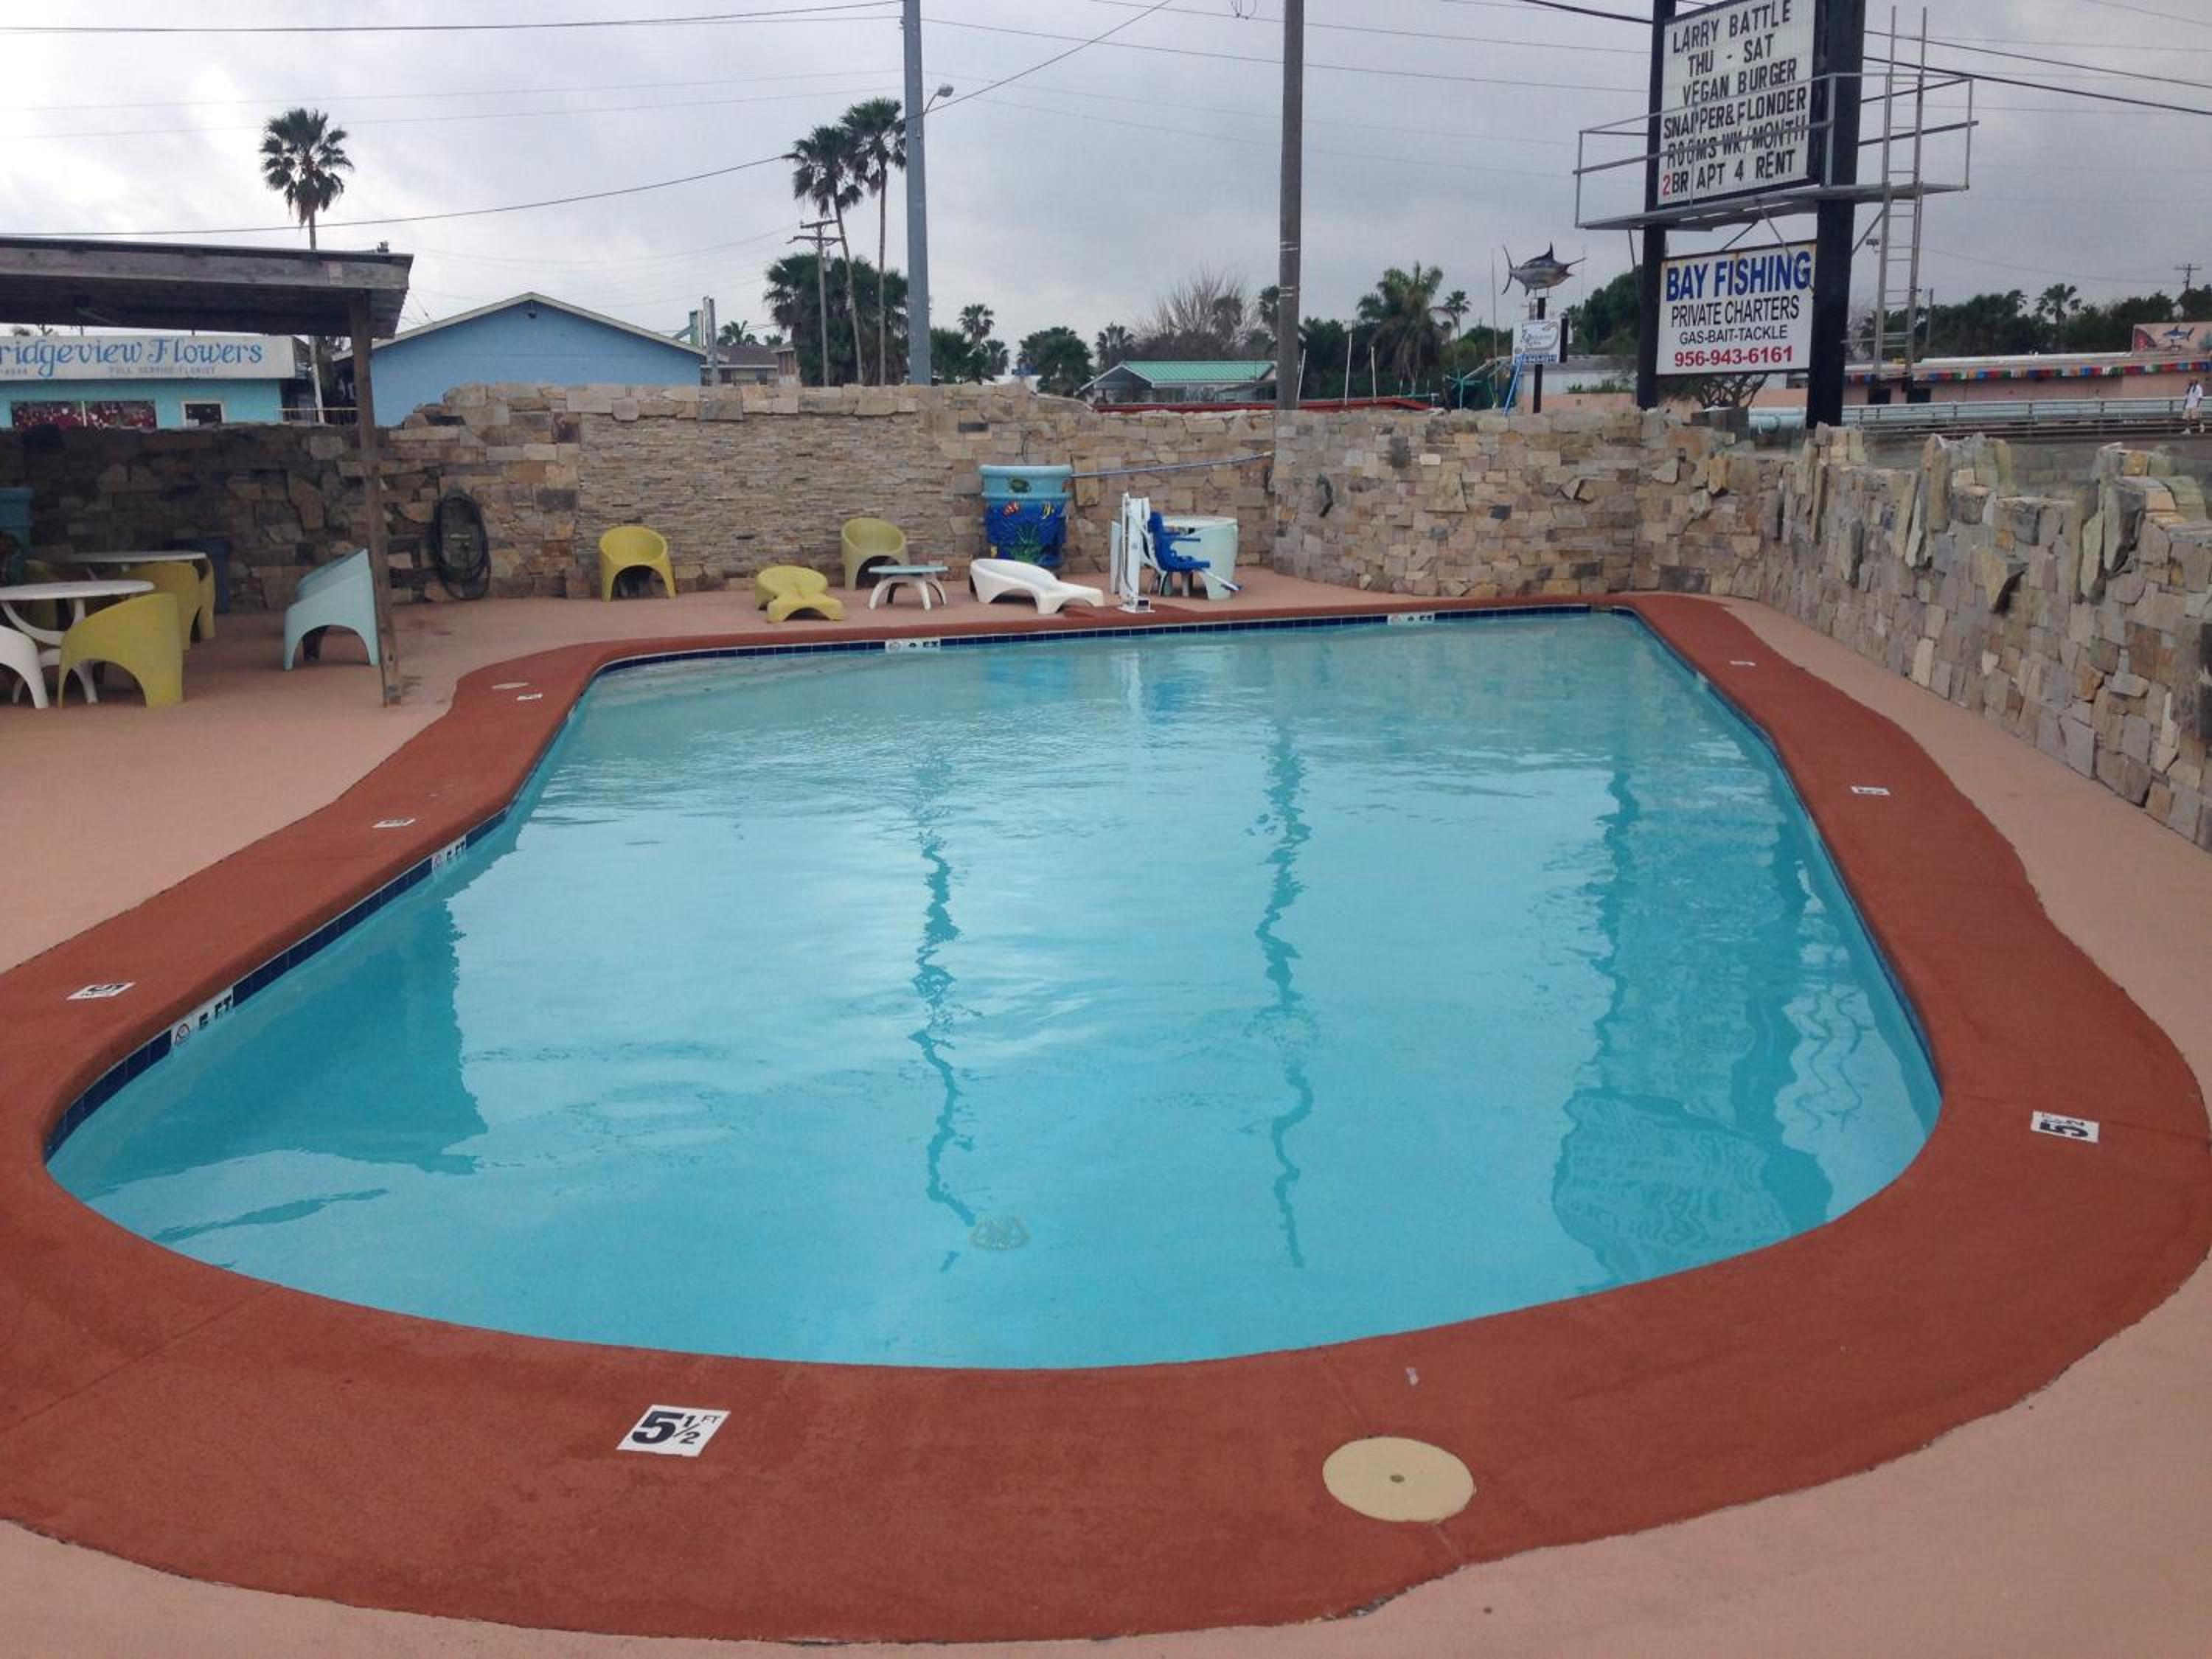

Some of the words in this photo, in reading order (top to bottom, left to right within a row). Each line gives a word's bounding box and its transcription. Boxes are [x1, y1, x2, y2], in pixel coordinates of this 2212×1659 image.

[1673, 18, 1720, 54] LARRY
[1729, 0, 1792, 37] BATTLE
[1688, 49, 1714, 77] THU
[1744, 34, 1774, 63] SAT
[1683, 75, 1729, 105] VEGAN
[1738, 58, 1797, 94] BURGER
[1667, 136, 1717, 169] ROOMS
[1663, 171, 1689, 195] 2BR
[1697, 163, 1725, 189] APT
[1734, 159, 1744, 181] 4
[1756, 149, 1795, 179] RENT
[1666, 261, 1709, 302] BAY
[1714, 251, 1812, 296] FISHING
[1671, 302, 1722, 328] PRIVATE
[1724, 295, 1800, 322] CHARTERS
[148, 338, 262, 364] Flowers
[1680, 325, 1788, 346] GAS-BAIT-TACKLE
[1674, 344, 1793, 367] 956-943-6161
[631, 1411, 685, 1444] 5
